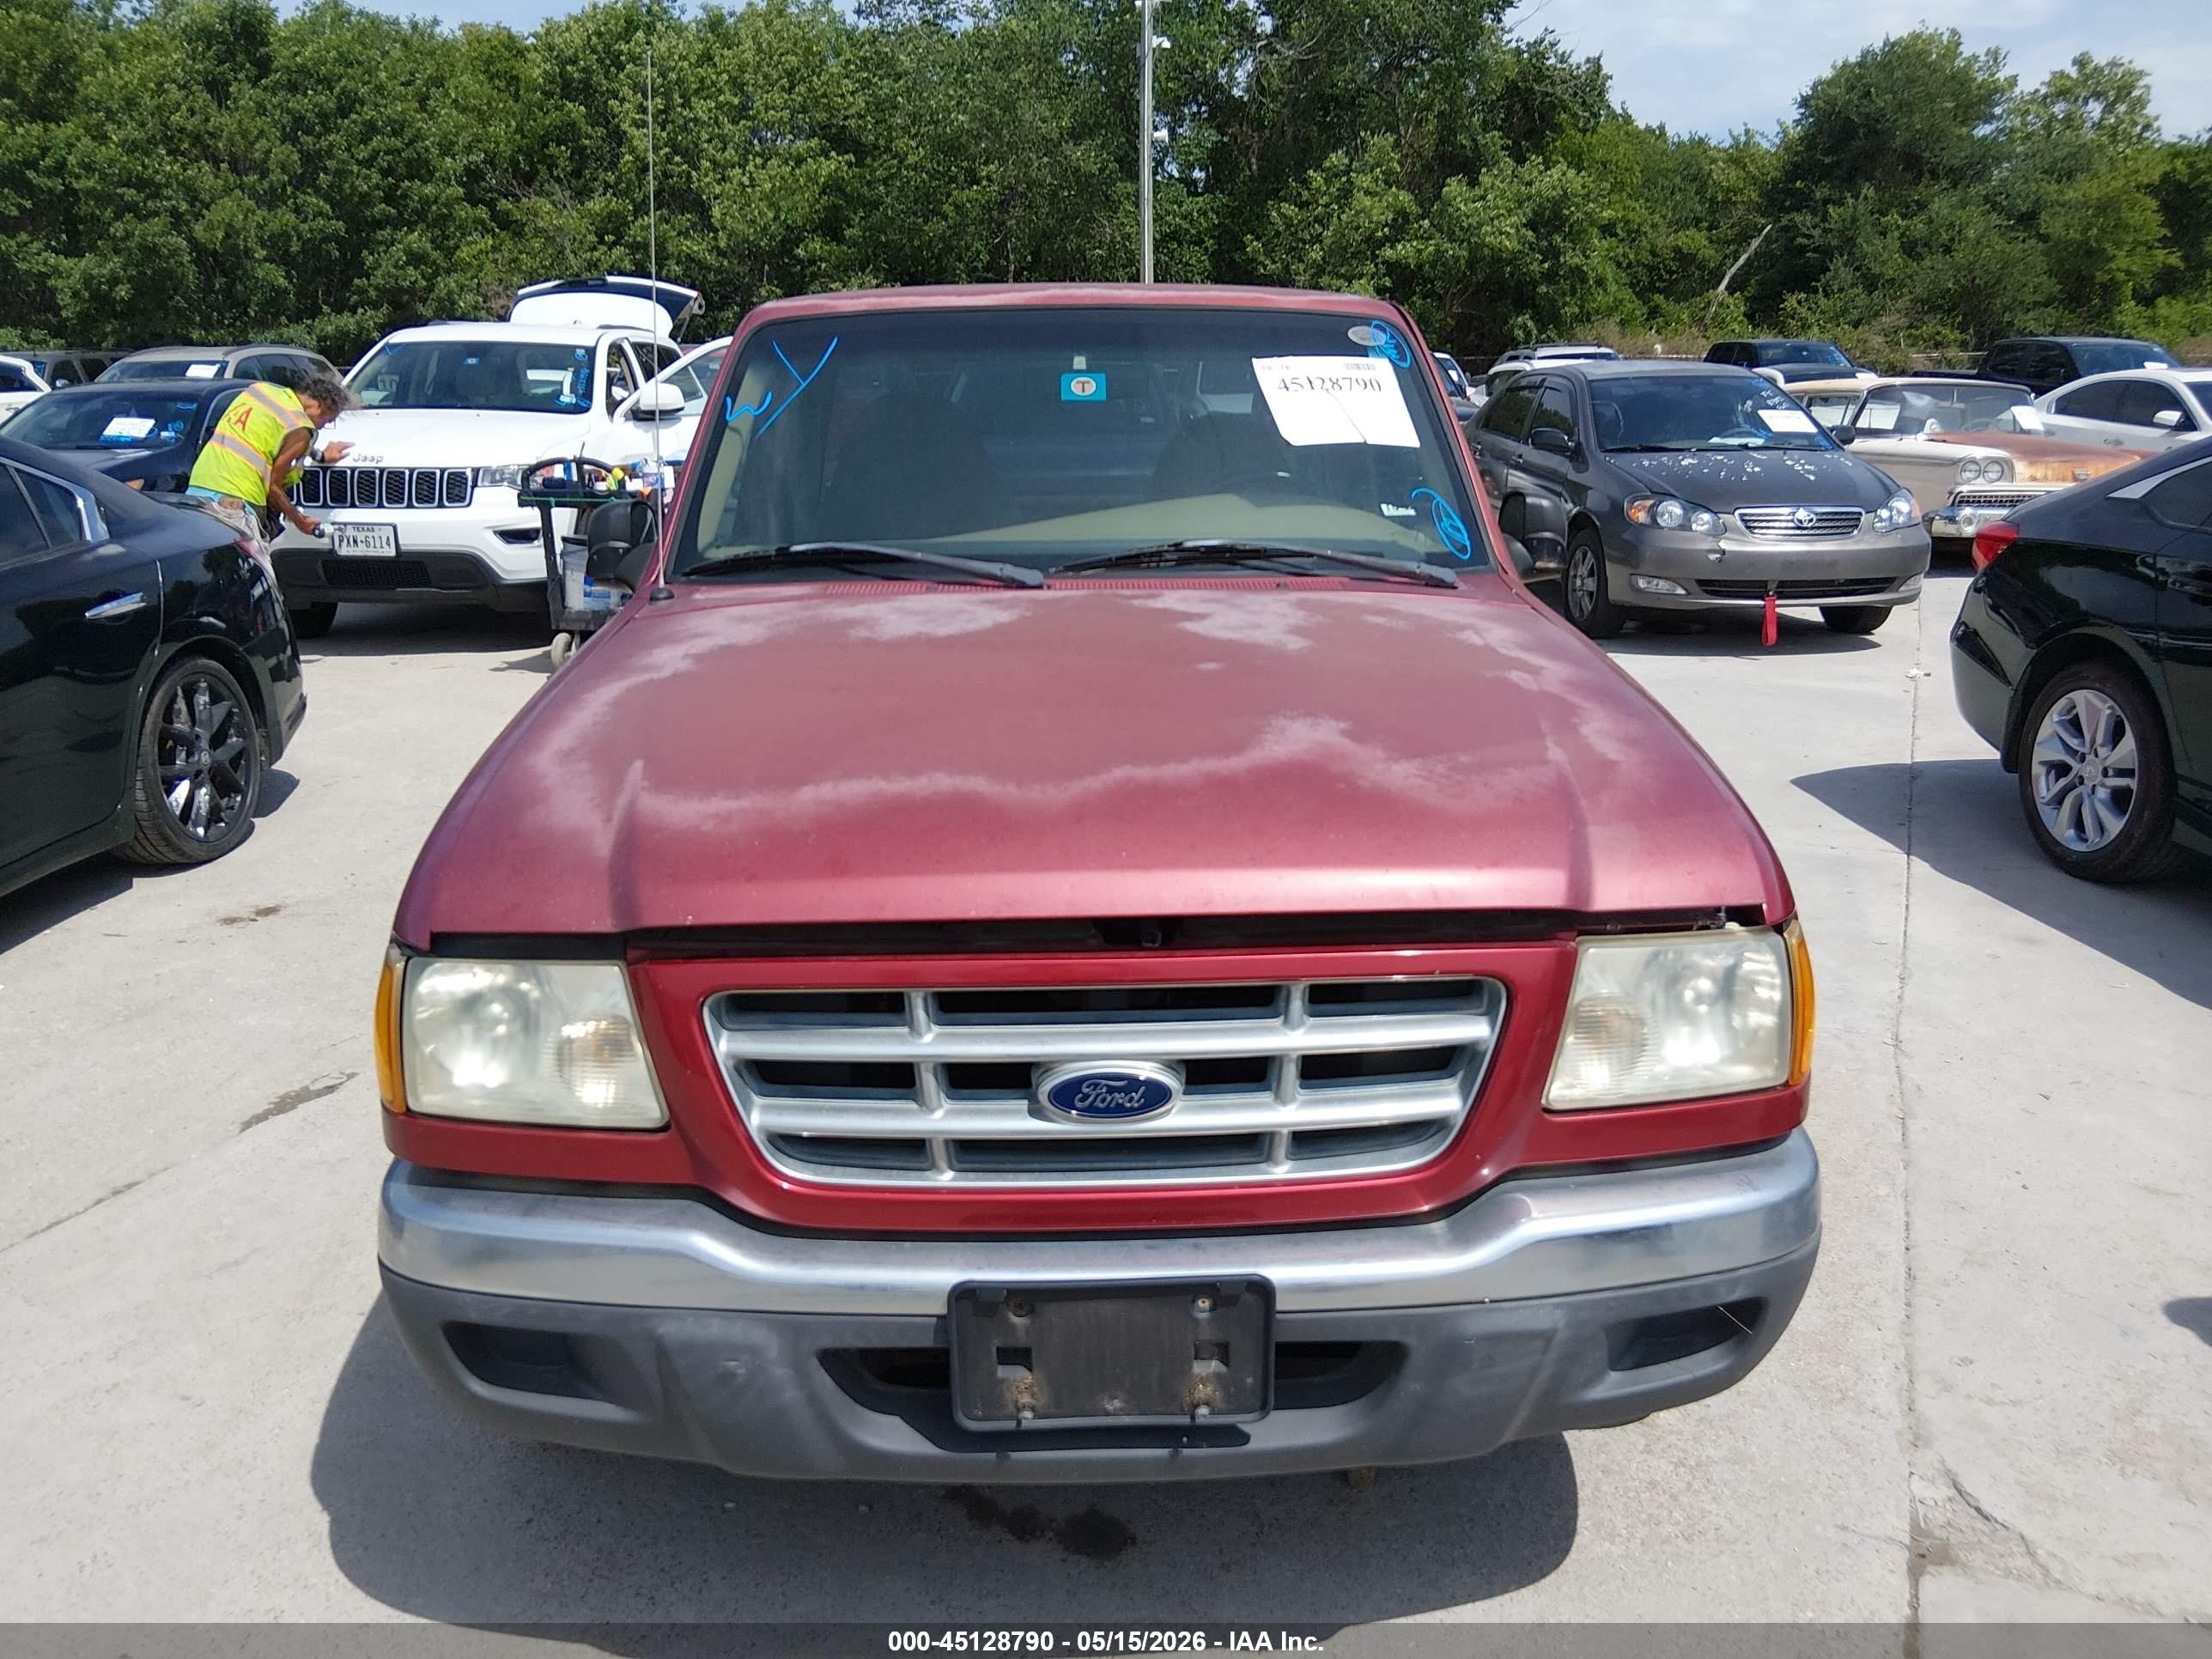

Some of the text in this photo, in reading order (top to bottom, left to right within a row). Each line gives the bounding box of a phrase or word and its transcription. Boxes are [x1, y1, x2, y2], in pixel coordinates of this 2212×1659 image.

[1278, 375, 1382, 392] 45128790
[352, 453, 385, 465] Jeep
[1074, 1079, 1146, 1108] Ford
